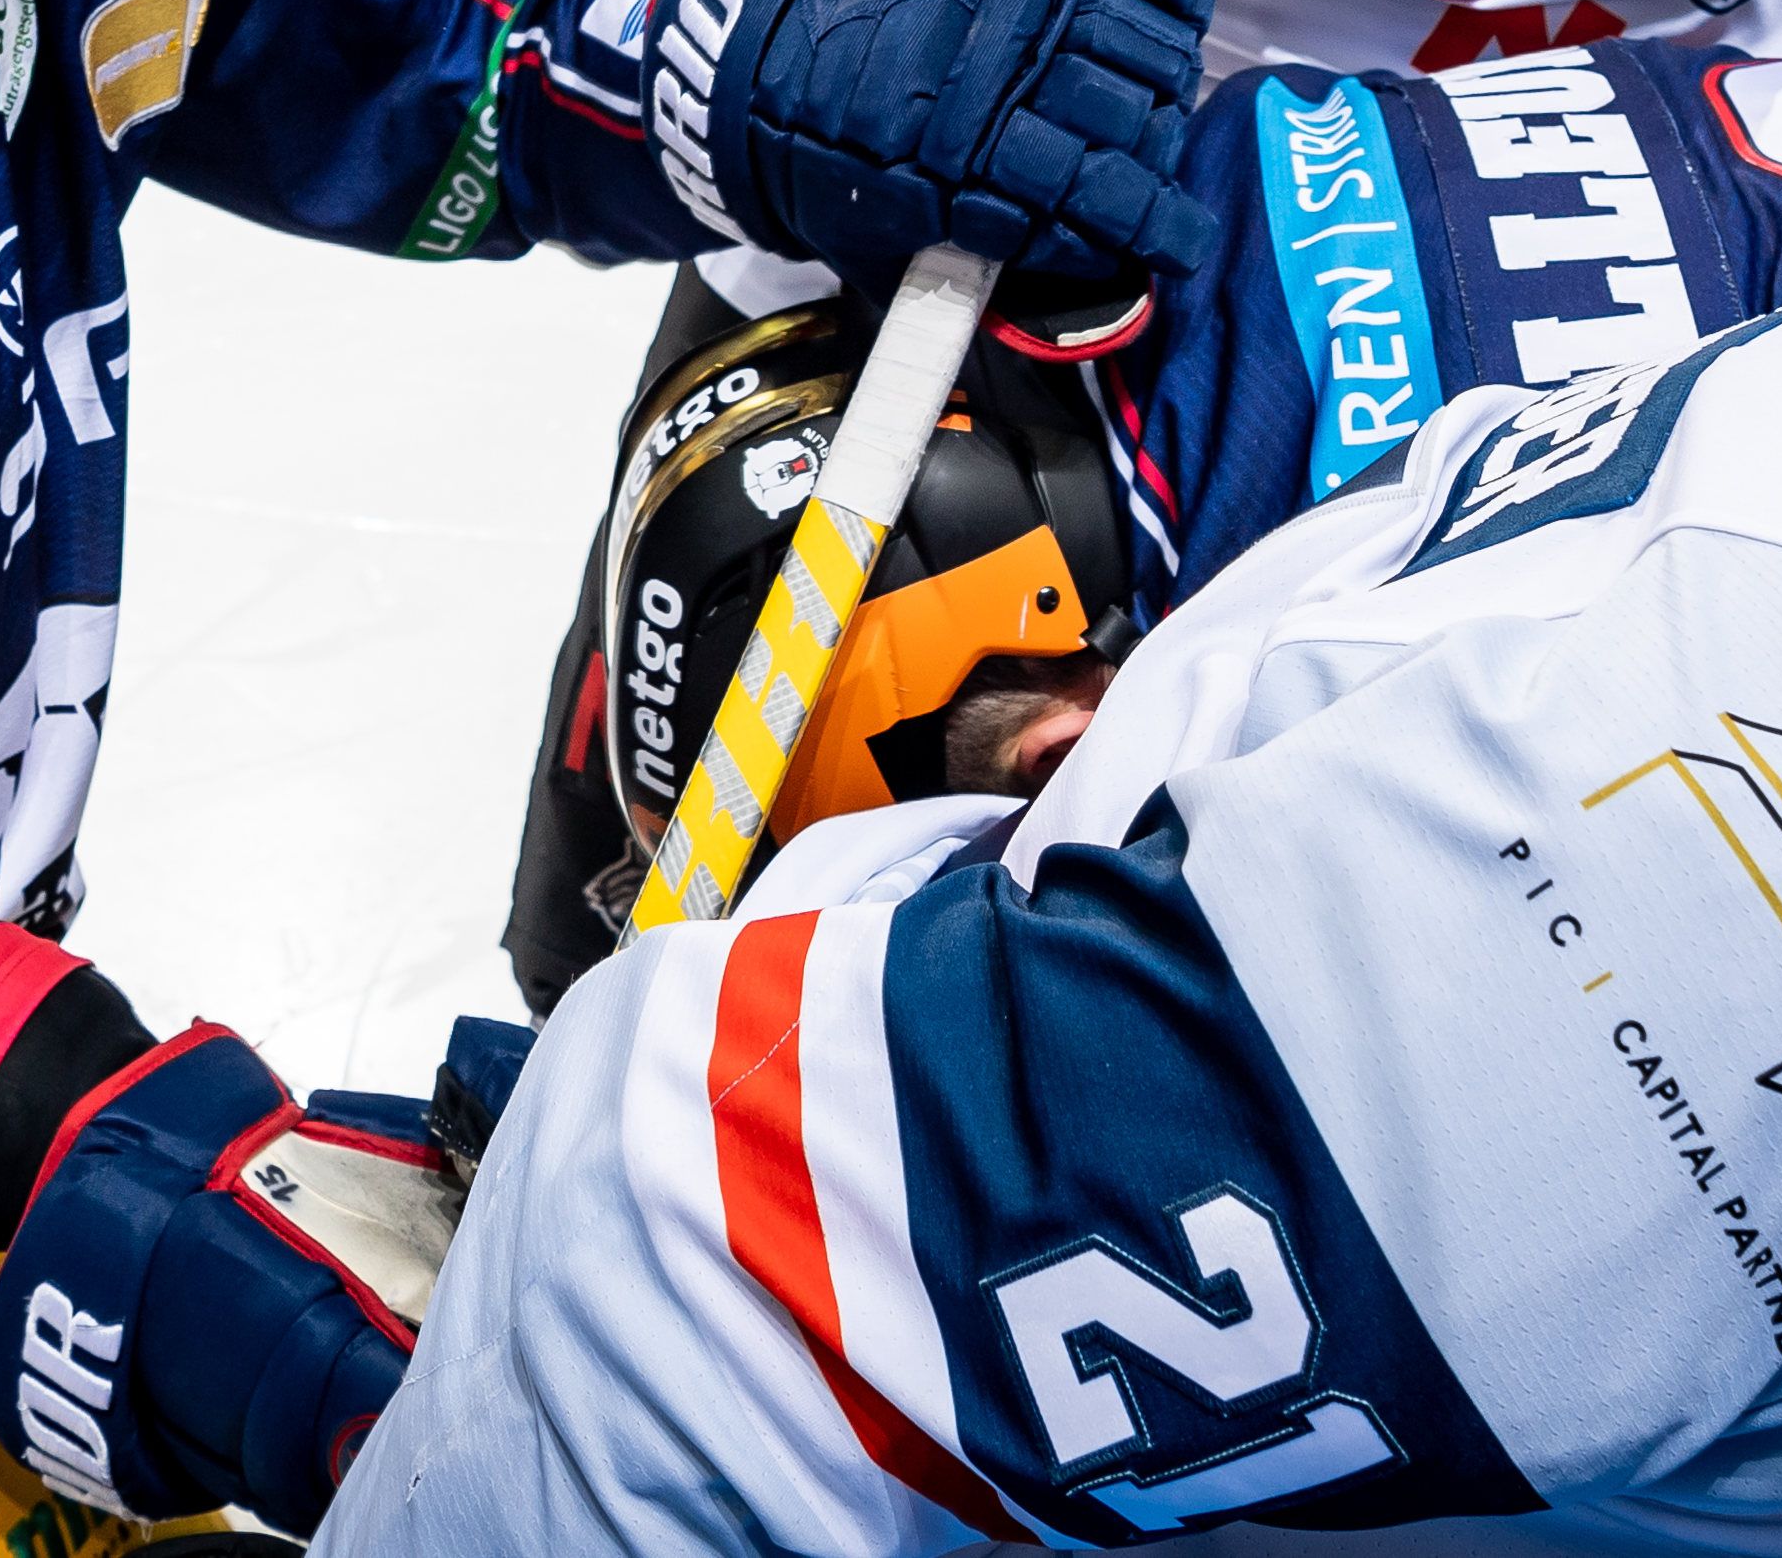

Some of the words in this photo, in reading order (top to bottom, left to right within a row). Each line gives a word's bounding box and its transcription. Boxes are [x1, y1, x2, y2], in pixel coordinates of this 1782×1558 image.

[417, 173, 487, 254] LIGO
[1315, 267, 1420, 446] REN
[626, 577, 685, 800] netgo
[1498, 836, 1584, 948] PIC
[1612, 1019, 1727, 1193] CAPITAL
[254, 1164, 300, 1203] 15
[978, 1180, 1408, 1542] 21
